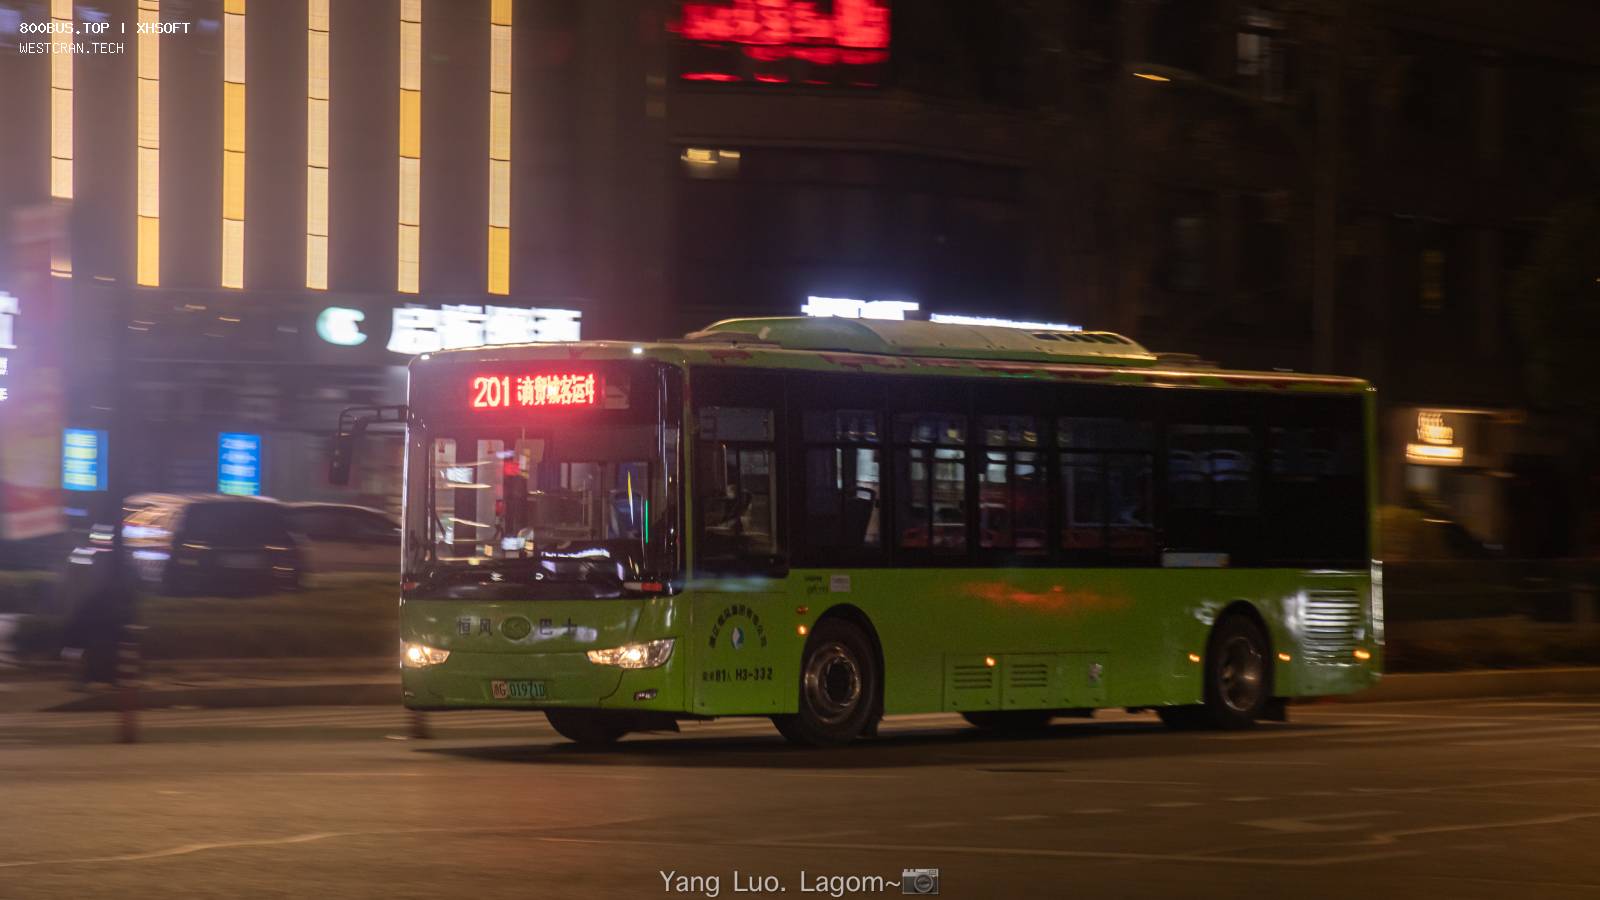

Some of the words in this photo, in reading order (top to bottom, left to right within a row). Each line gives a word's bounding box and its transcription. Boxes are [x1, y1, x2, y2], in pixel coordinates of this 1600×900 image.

[474, 376, 510, 407] 201
[517, 373, 595, 406] 商贸城客运中
[457, 617, 492, 636] 恒风
[538, 615, 577, 636] 巴士
